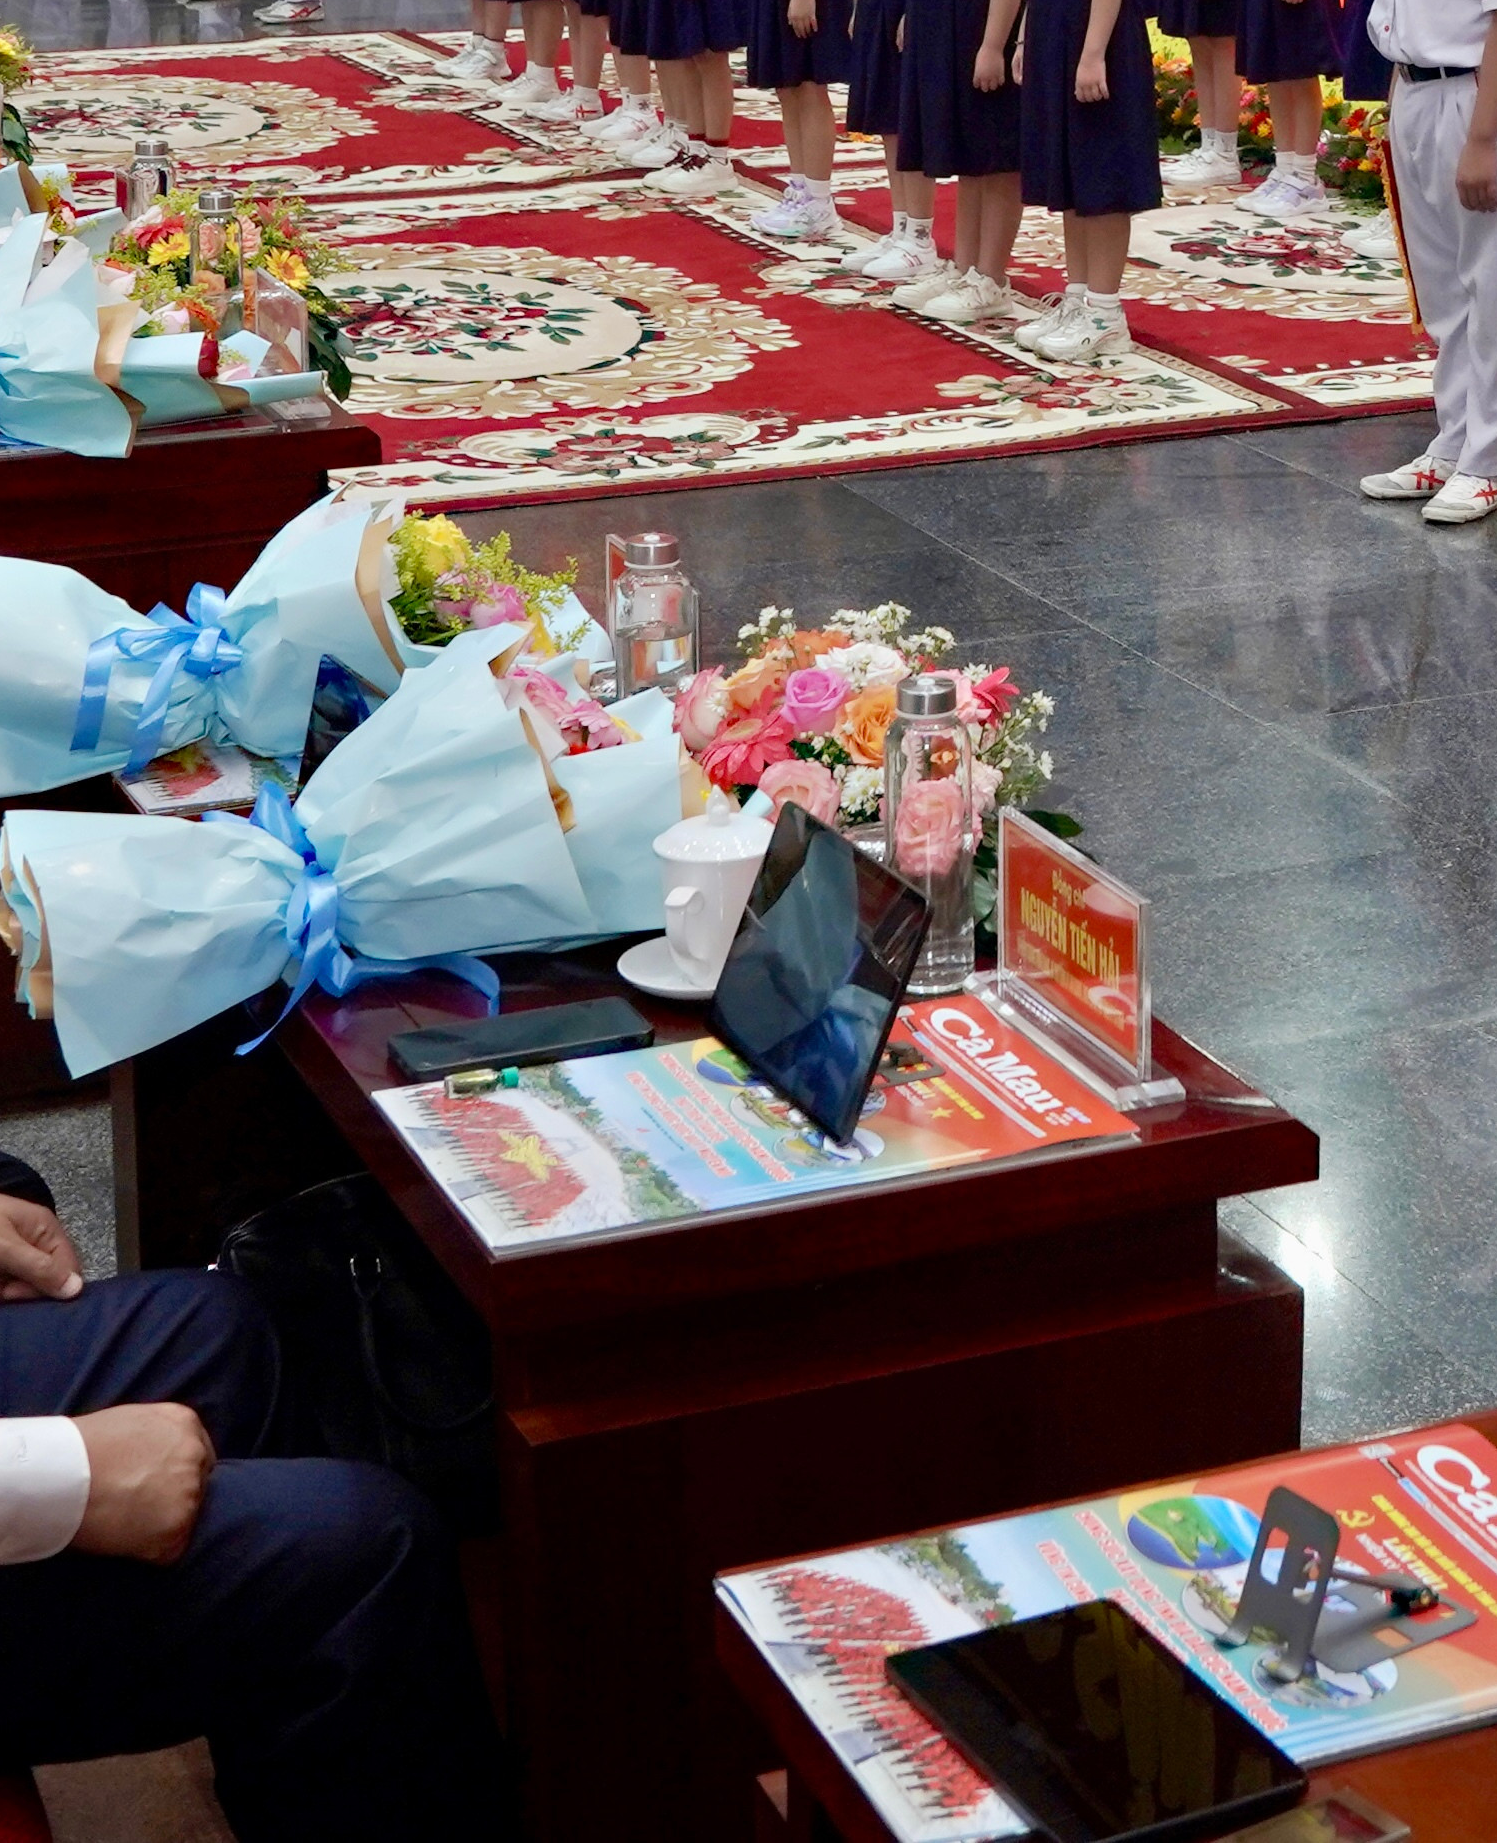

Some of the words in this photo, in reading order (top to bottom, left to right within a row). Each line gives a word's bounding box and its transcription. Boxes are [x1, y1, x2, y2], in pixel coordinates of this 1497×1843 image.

[1020, 887, 1067, 955] NGUYỄN
[1069, 920, 1097, 977] TIẾN
[1099, 936, 1120, 991] HẢI
[929, 1007, 995, 1057] Cà
[974, 1051, 1064, 1114] Mau
